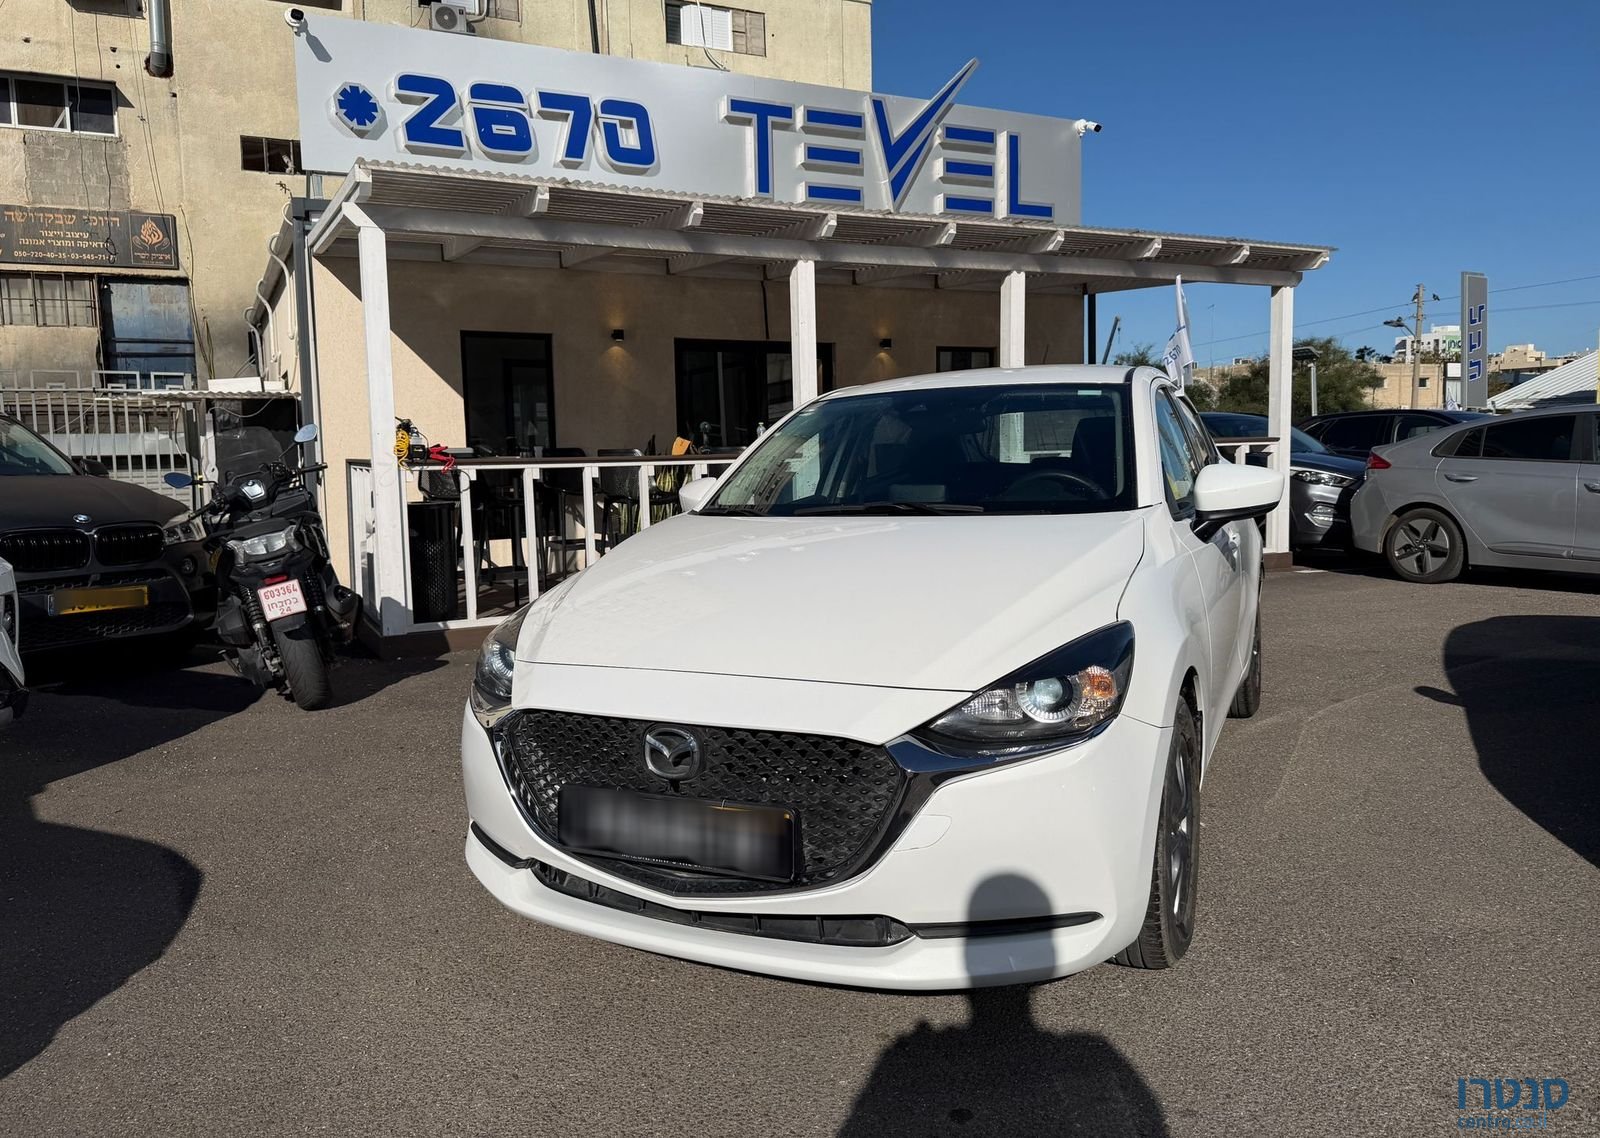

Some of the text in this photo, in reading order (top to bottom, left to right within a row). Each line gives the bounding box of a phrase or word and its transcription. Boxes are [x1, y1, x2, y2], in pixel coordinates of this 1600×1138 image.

[724, 57, 1055, 219] TEVEL
[38, 229, 90, 239] עיצוב וייצור
[18, 237, 46, 246] אמונה
[47, 238, 75, 247] ומוצרי
[263, 583, 298, 600] 603364
[279, 606, 292, 615] 24
